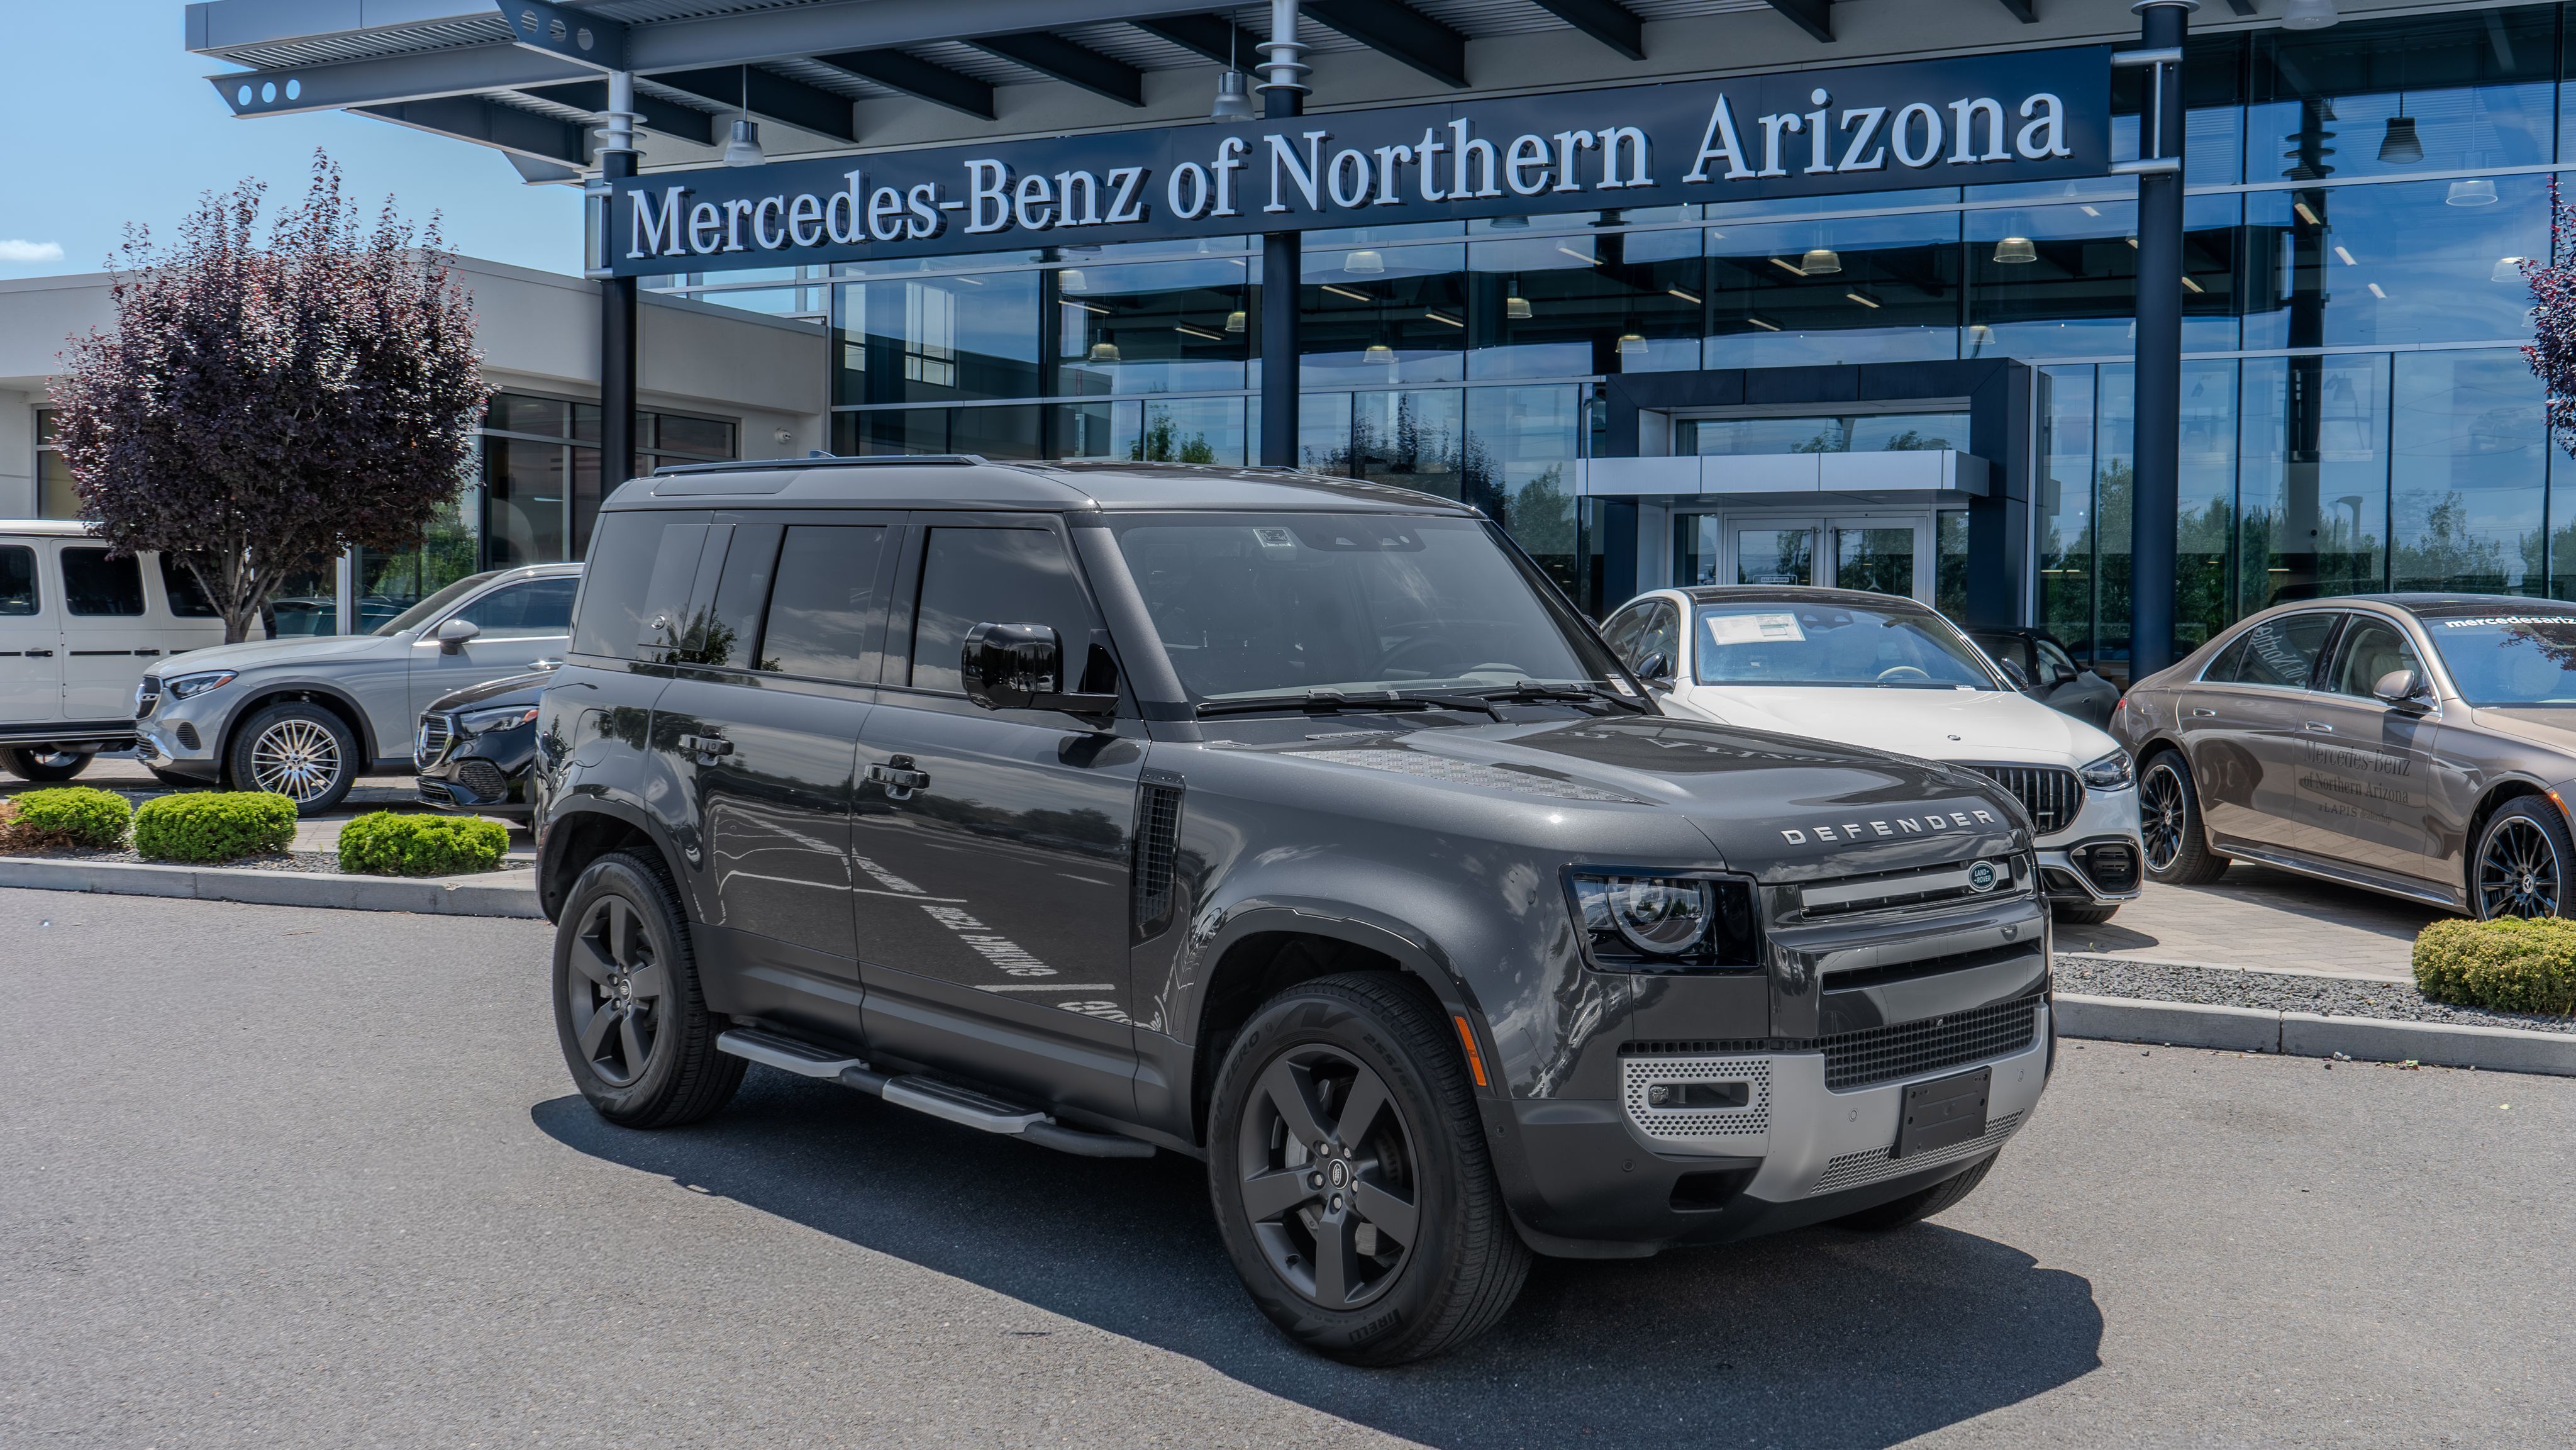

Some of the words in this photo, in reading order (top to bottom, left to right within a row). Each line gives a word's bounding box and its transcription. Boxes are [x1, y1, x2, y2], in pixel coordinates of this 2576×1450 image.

[625, 157, 1151, 260] Mercedes-Benz
[1168, 136, 1253, 221] of
[1263, 117, 1658, 215] Northern
[1683, 87, 2075, 184] Arizona
[2304, 740, 2411, 777] Mercedes-Benz
[2304, 772, 2313, 787] of
[2316, 772, 2362, 796] Northern
[2365, 781, 2409, 804] Arizona
[1780, 810, 1995, 845] DEFENDER
[2324, 803, 2358, 818] LAPIS
[2360, 808, 2391, 825] dealership
[1975, 869, 1987, 877] LAND
[1977, 875, 1991, 883] ROVER
[1224, 1030, 1260, 1093] ZERO
